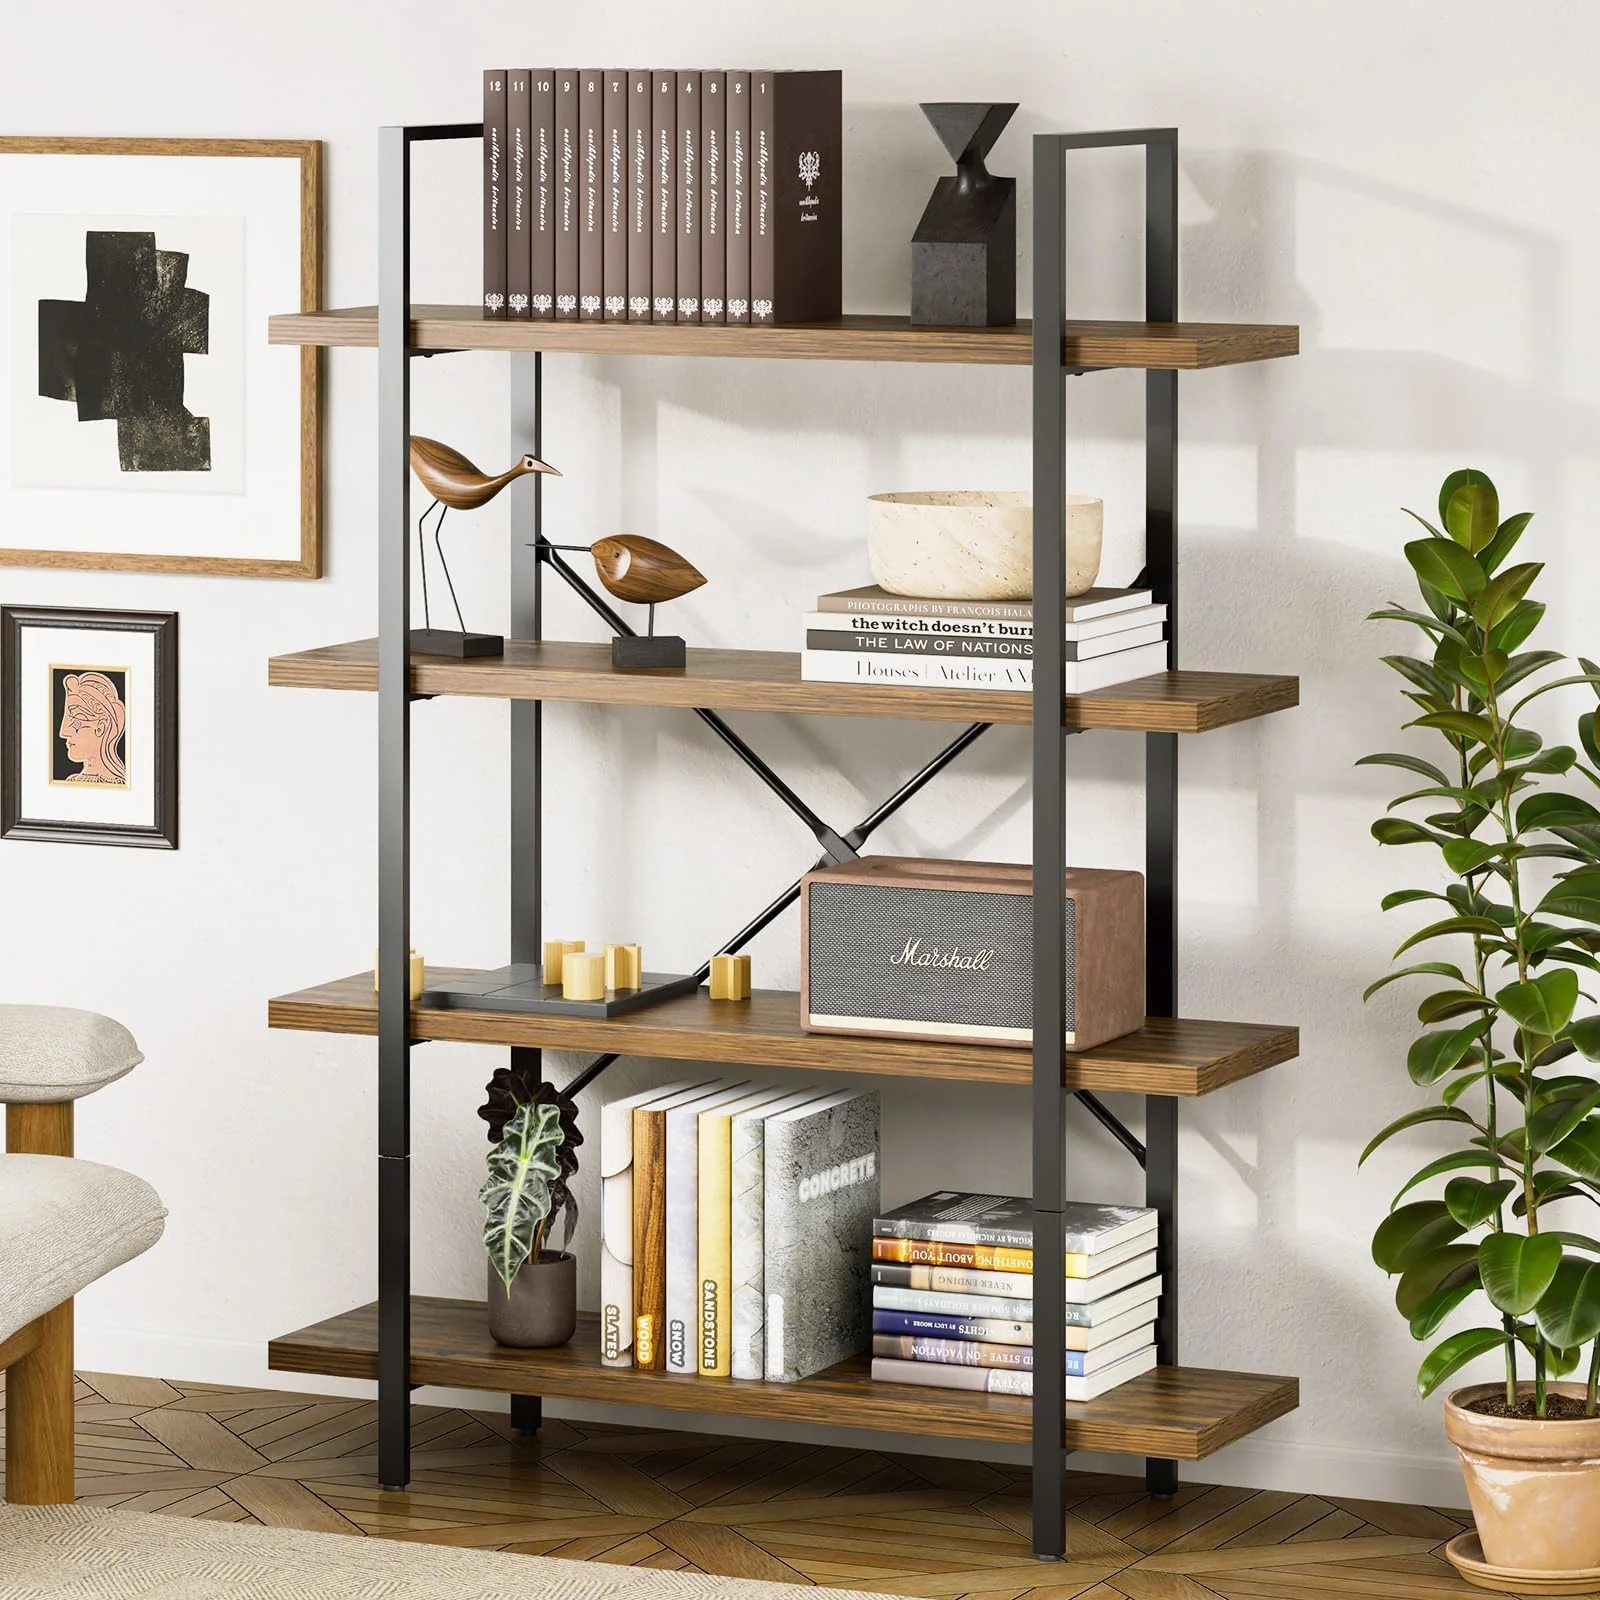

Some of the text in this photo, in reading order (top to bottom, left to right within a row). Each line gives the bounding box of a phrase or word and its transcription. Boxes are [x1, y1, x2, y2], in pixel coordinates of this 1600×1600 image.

[489, 80, 501, 92] 12
[513, 81, 524, 92] 11
[537, 81, 550, 92] 10
[563, 81, 570, 92] 9
[588, 81, 595, 93] 8
[612, 81, 619, 93] 7
[636, 82, 644, 93] 6
[661, 82, 668, 93] 5
[685, 82, 692, 93] 4
[735, 83, 742, 94] 2
[760, 83, 765, 94] 1
[847, 601, 1033, 618] PHOTOGRAPHS BY FRANÇOIS HALA
[851, 617, 880, 630] the
[881, 618, 930, 632] witch
[855, 636, 1034, 655] THE LAW OF NATIONS
[856, 660, 919, 678] Houses
[938, 665, 996, 682] Atelier
[890, 936, 994, 971] Marshall
[799, 1152, 876, 1203] CONCRETE
[911, 1249, 1034, 1269] OMETHING ABOUT YOU
[938, 1275, 1013, 1291] NEVER ENDING
[704, 1280, 716, 1368] SANDSTONE
[605, 1305, 618, 1360] SLATES
[638, 1316, 651, 1362] WOOD
[671, 1321, 684, 1367] SNOW
[911, 1344, 963, 1360] VACATION
[966, 1350, 981, 1361] ON
[989, 1352, 1021, 1364] STEVE
